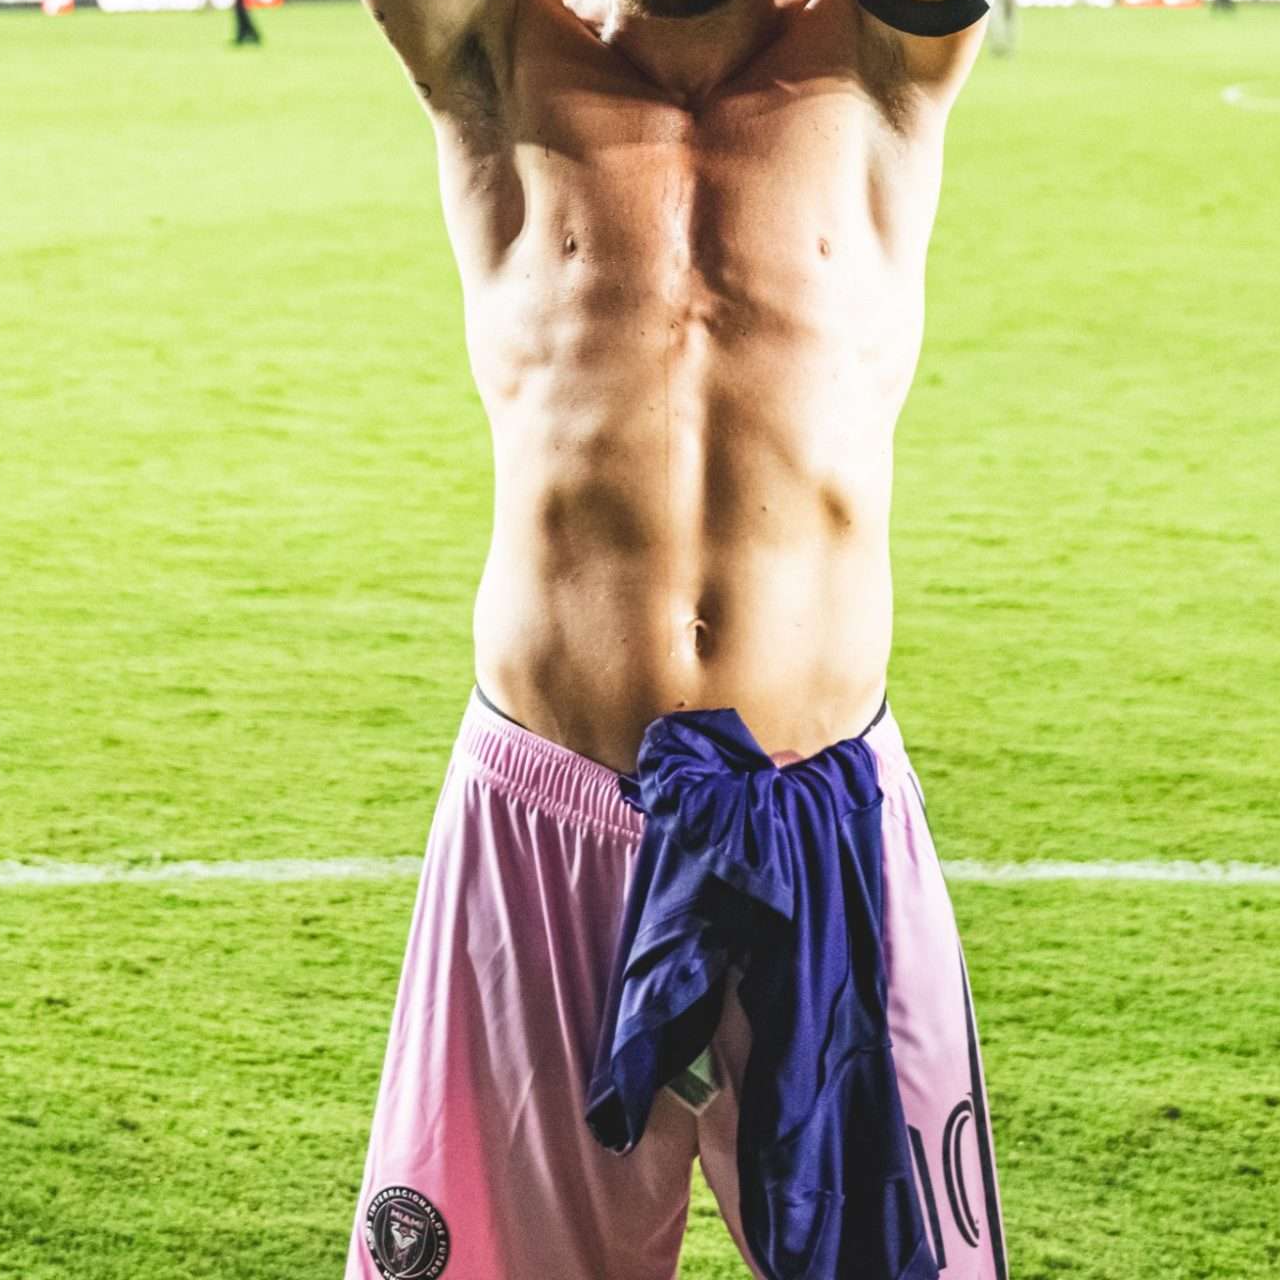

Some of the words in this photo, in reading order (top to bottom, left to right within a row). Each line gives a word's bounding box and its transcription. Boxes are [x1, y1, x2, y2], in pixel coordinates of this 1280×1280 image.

[367, 1187, 437, 1219] INTERNACIONAL
[433, 1221, 447, 1237] DE
[425, 1239, 448, 1279] FUTBOL
